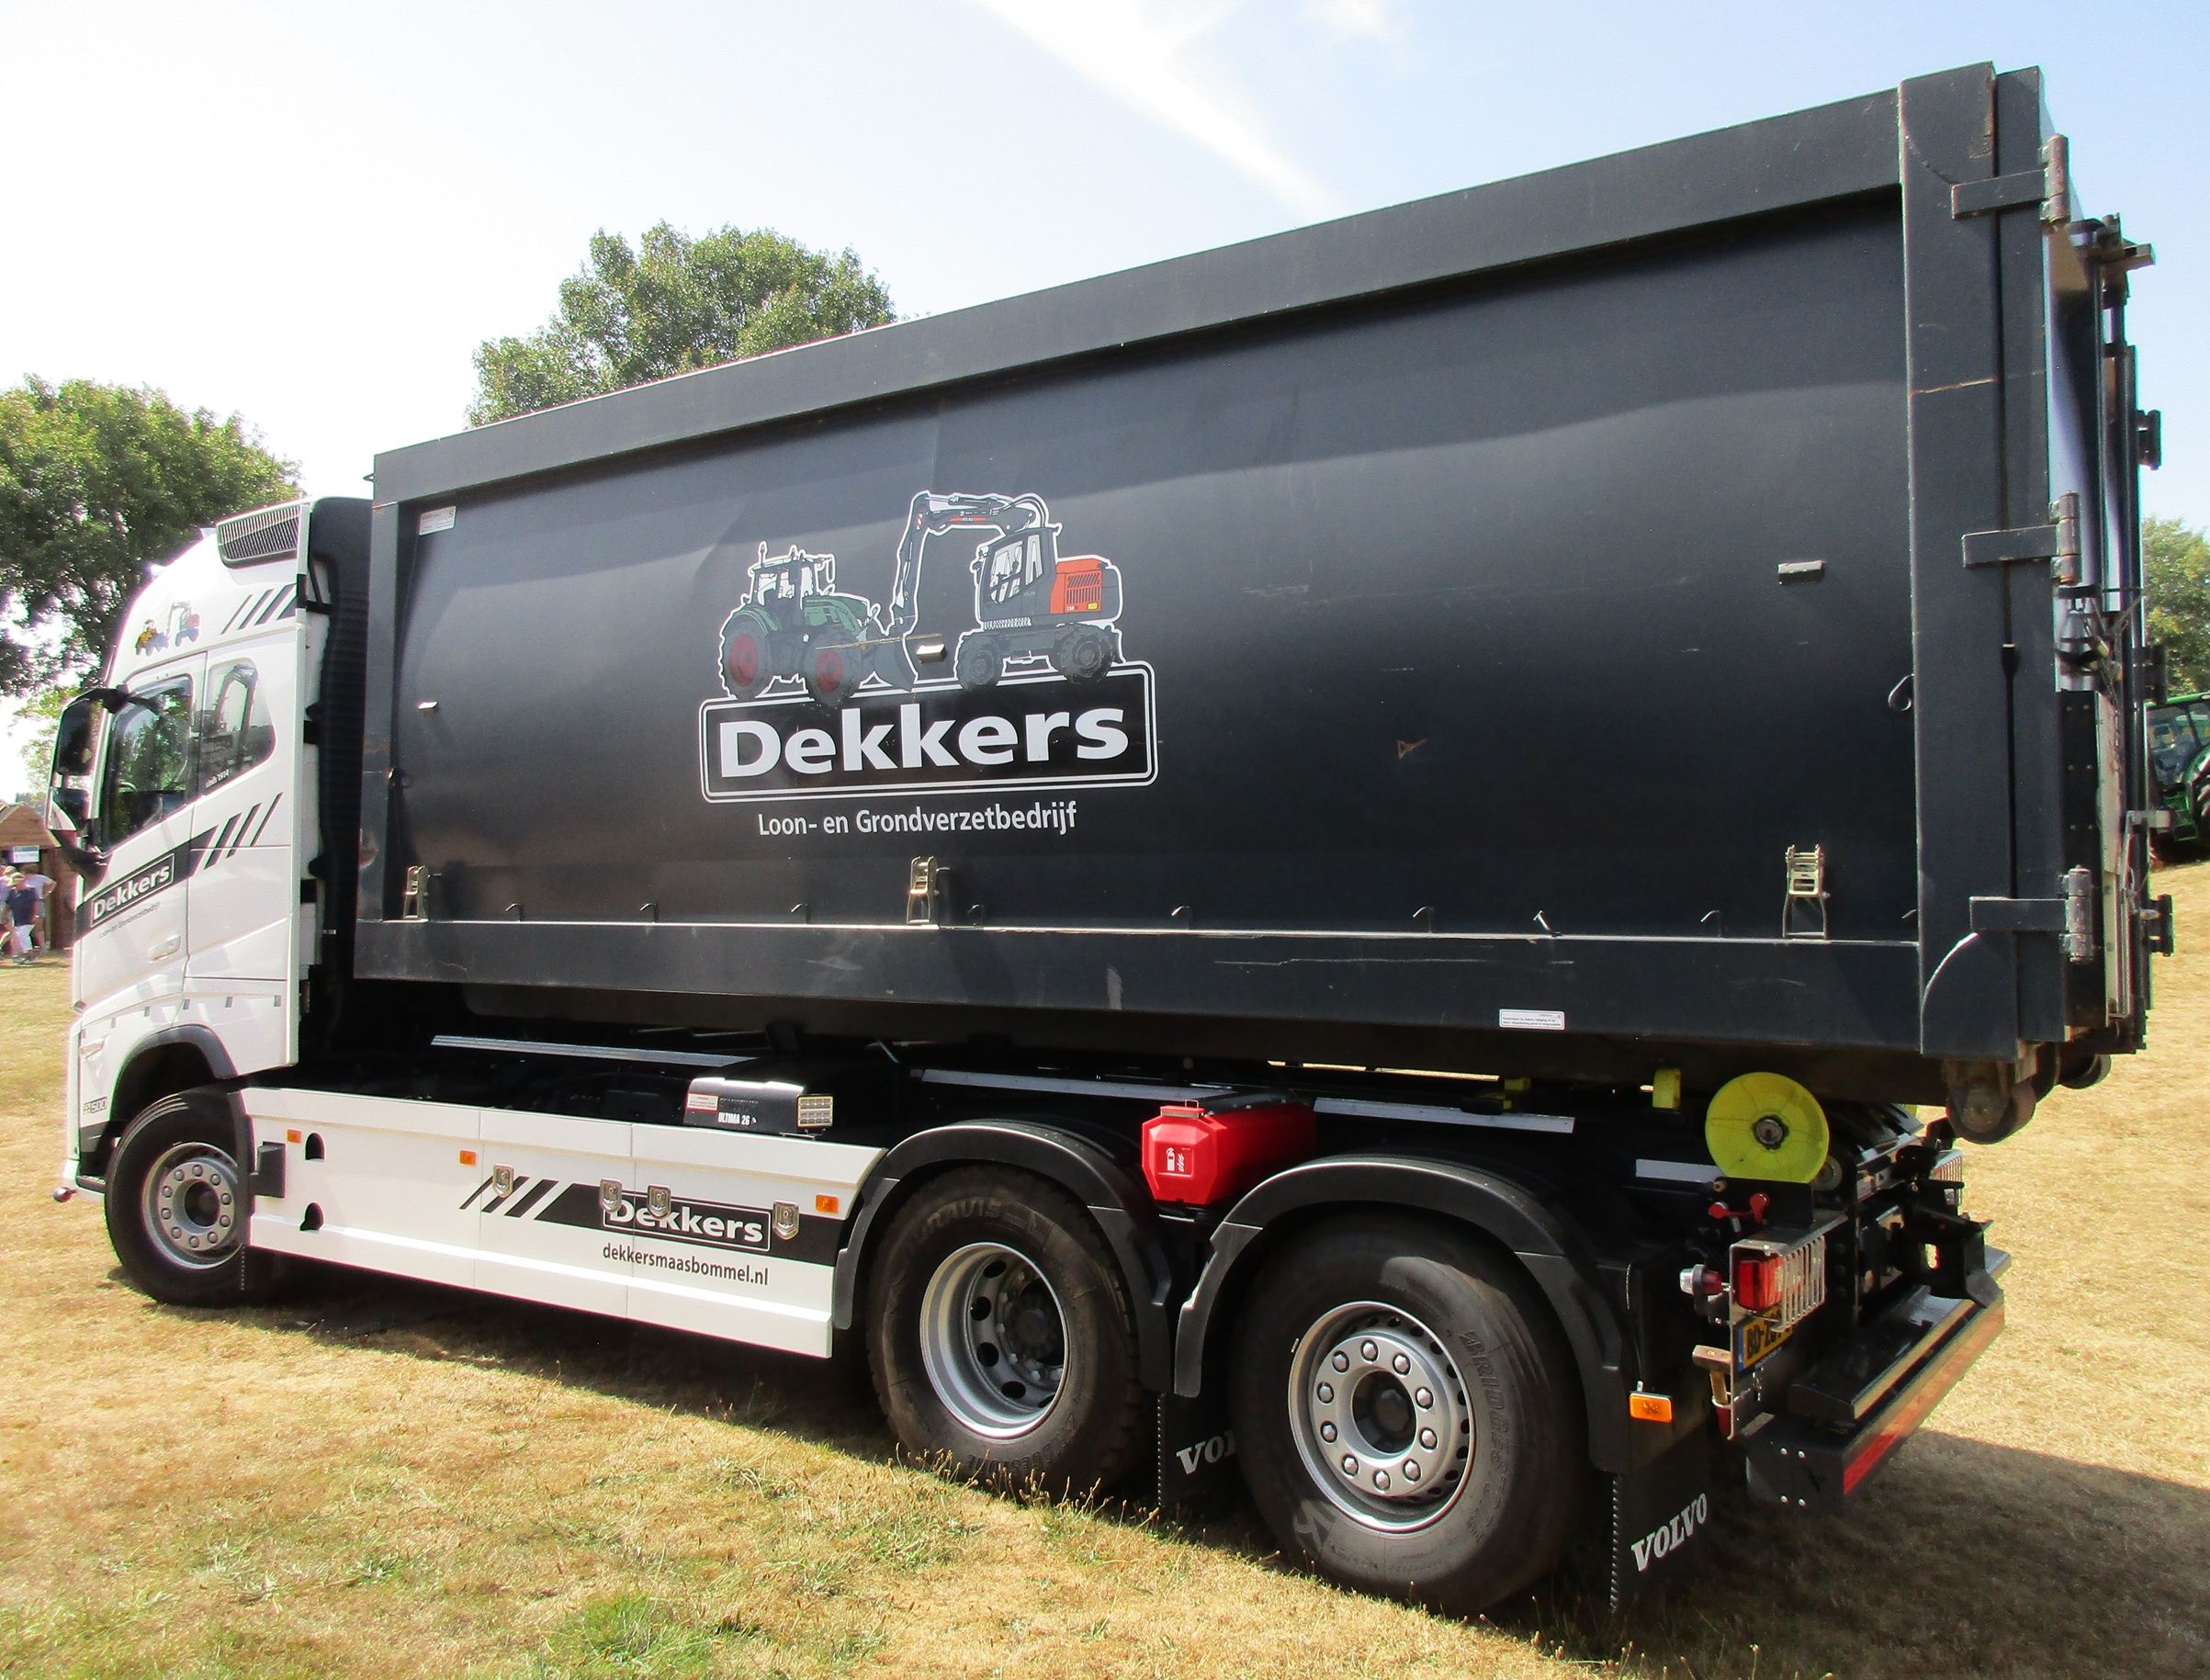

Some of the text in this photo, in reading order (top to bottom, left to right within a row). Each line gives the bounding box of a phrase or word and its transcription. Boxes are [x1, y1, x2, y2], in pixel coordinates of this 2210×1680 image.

[719, 703, 1129, 778] Dekkers
[758, 800, 1078, 836] Loon- en Grondverzetbedrijf
[94, 865, 170, 920] Dekkers
[717, 1111, 740, 1125] ULTIMA
[609, 1200, 764, 1243] Dekkers
[603, 1242, 769, 1286] dekkersmaasbommel.nl
[1176, 1429, 1236, 1475] VOL
[1630, 1493, 1708, 1573] VOLVO
